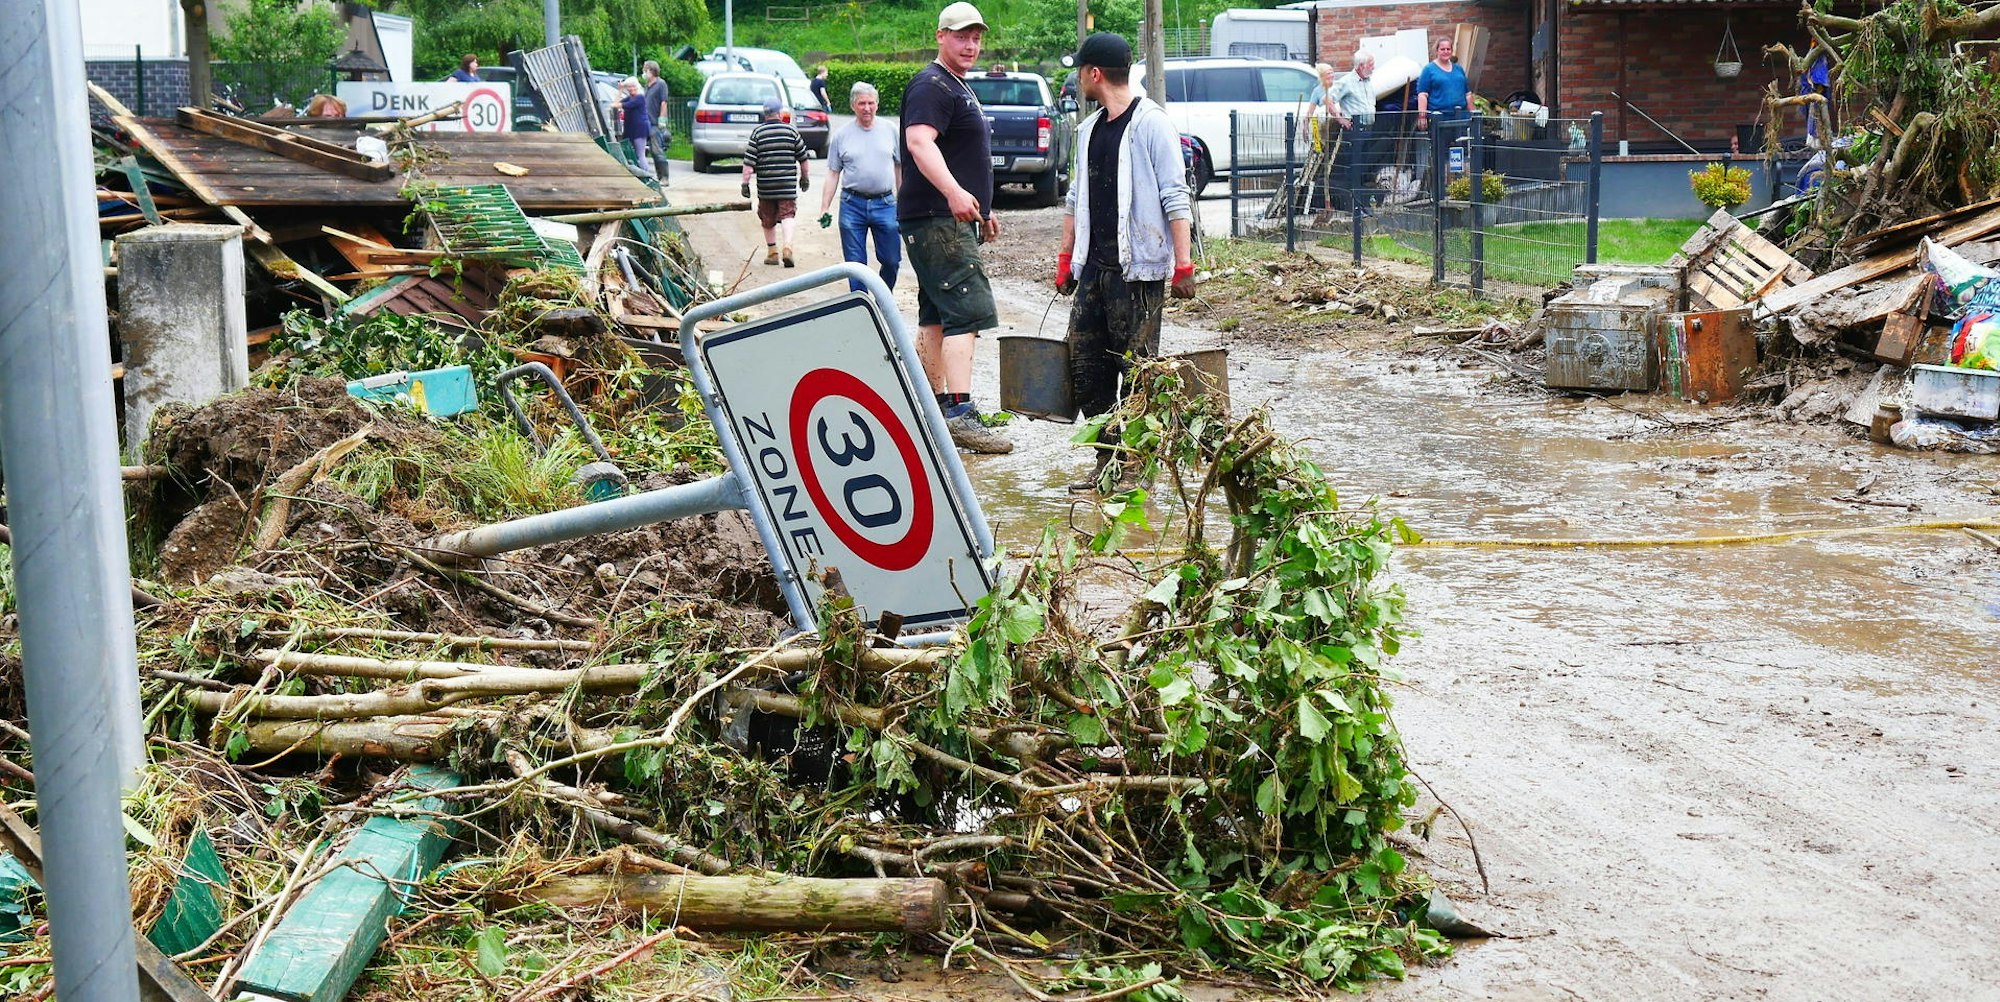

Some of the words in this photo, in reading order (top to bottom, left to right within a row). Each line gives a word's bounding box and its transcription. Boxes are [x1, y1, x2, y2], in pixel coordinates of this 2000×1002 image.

[372, 91, 430, 111] DENK
[471, 103, 498, 127] 30
[742, 411, 825, 560] ZONE
[817, 410, 902, 529] 30
